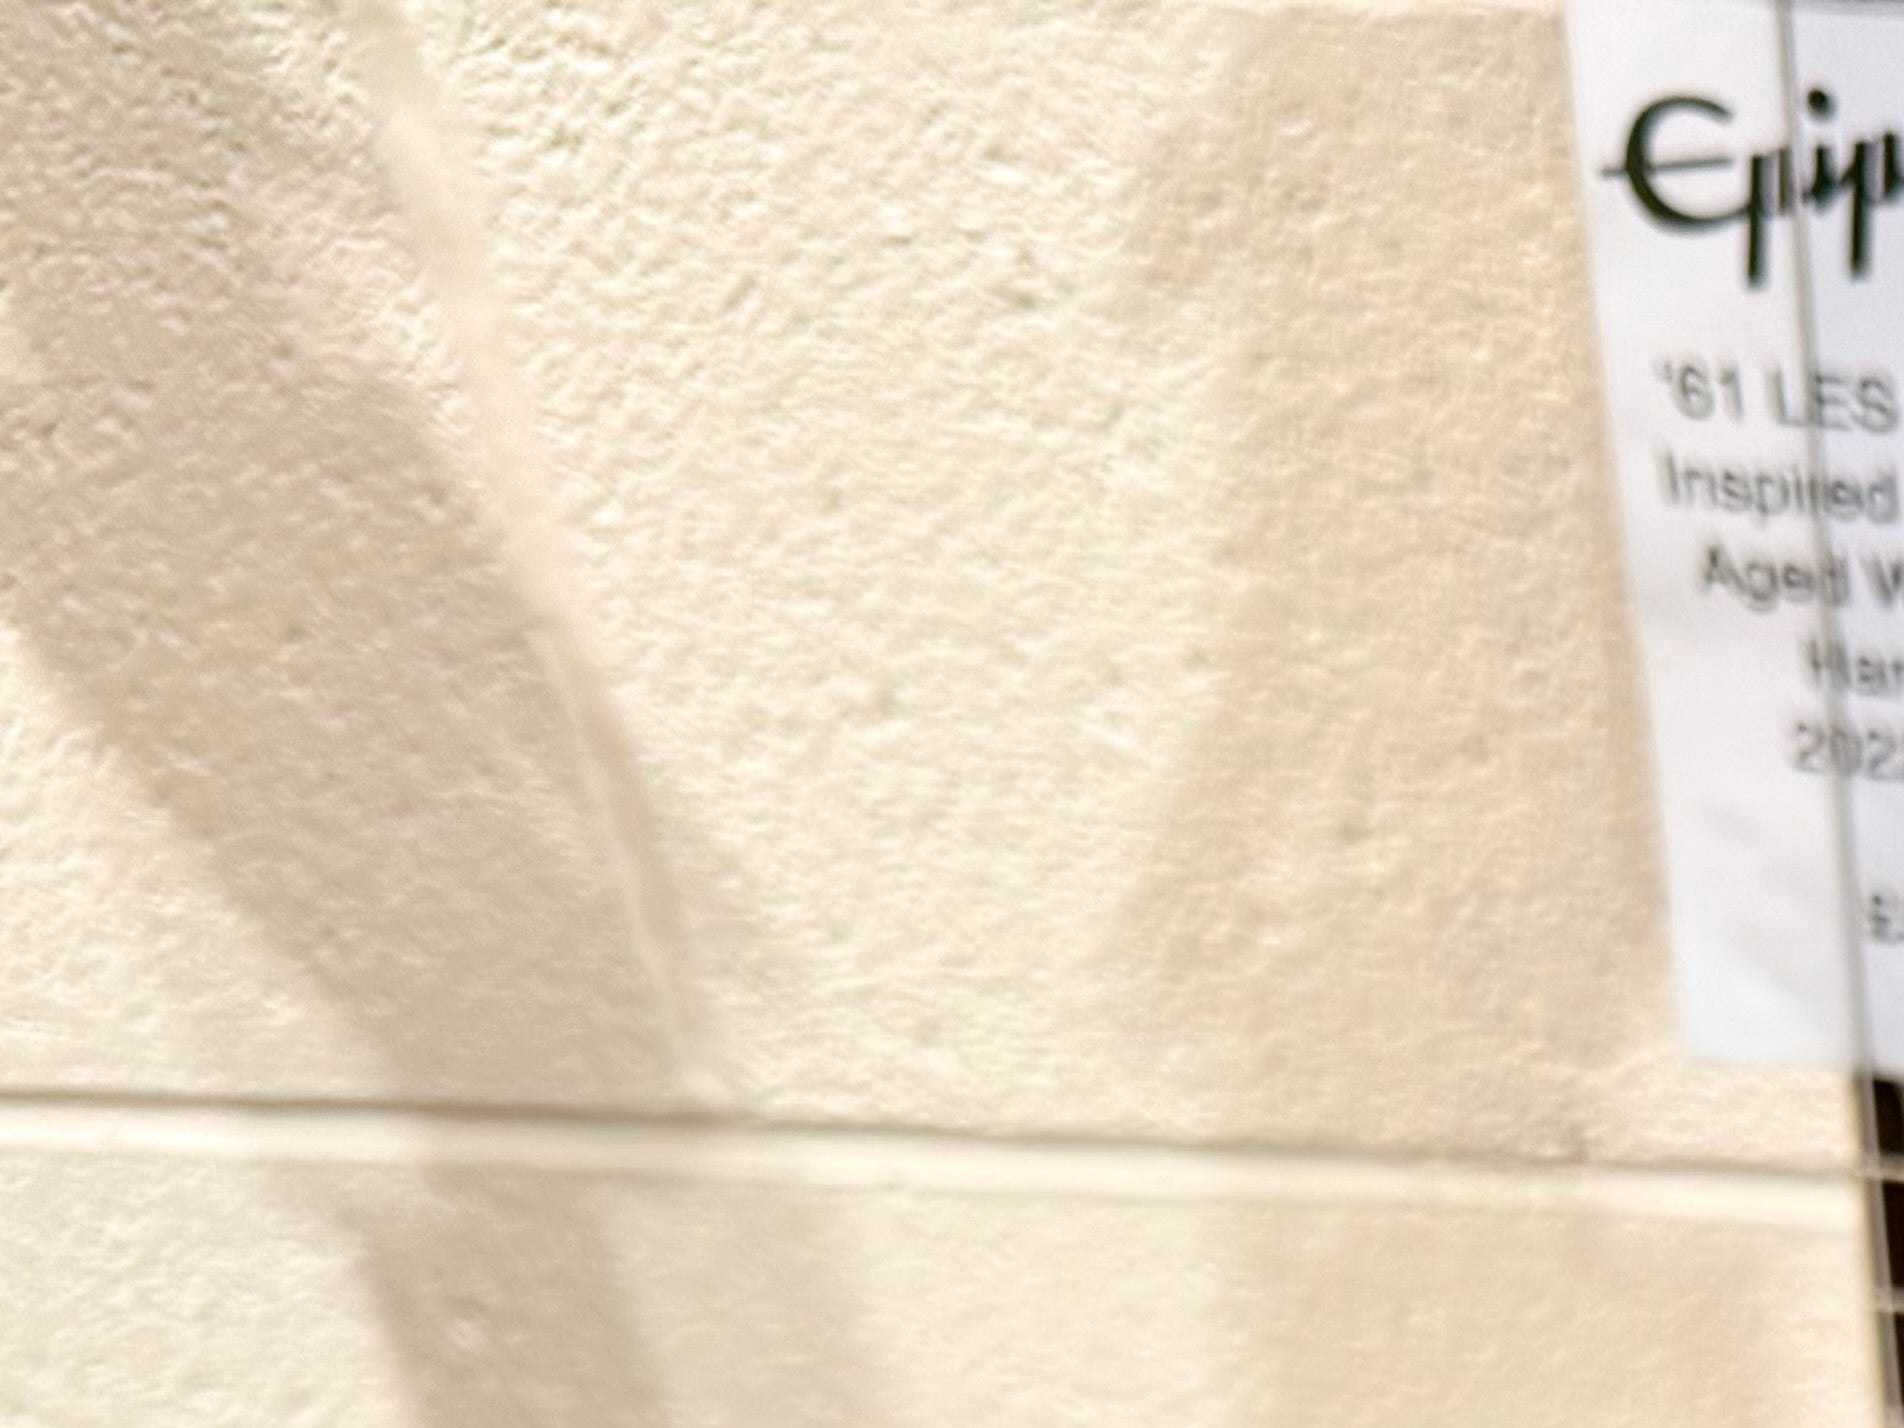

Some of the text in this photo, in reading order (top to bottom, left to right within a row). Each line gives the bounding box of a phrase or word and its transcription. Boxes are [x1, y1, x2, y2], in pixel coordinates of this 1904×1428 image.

[1768, 366, 1898, 435] LES
[1658, 452, 1902, 526] Inspired
[1696, 540, 1851, 617] Aged
